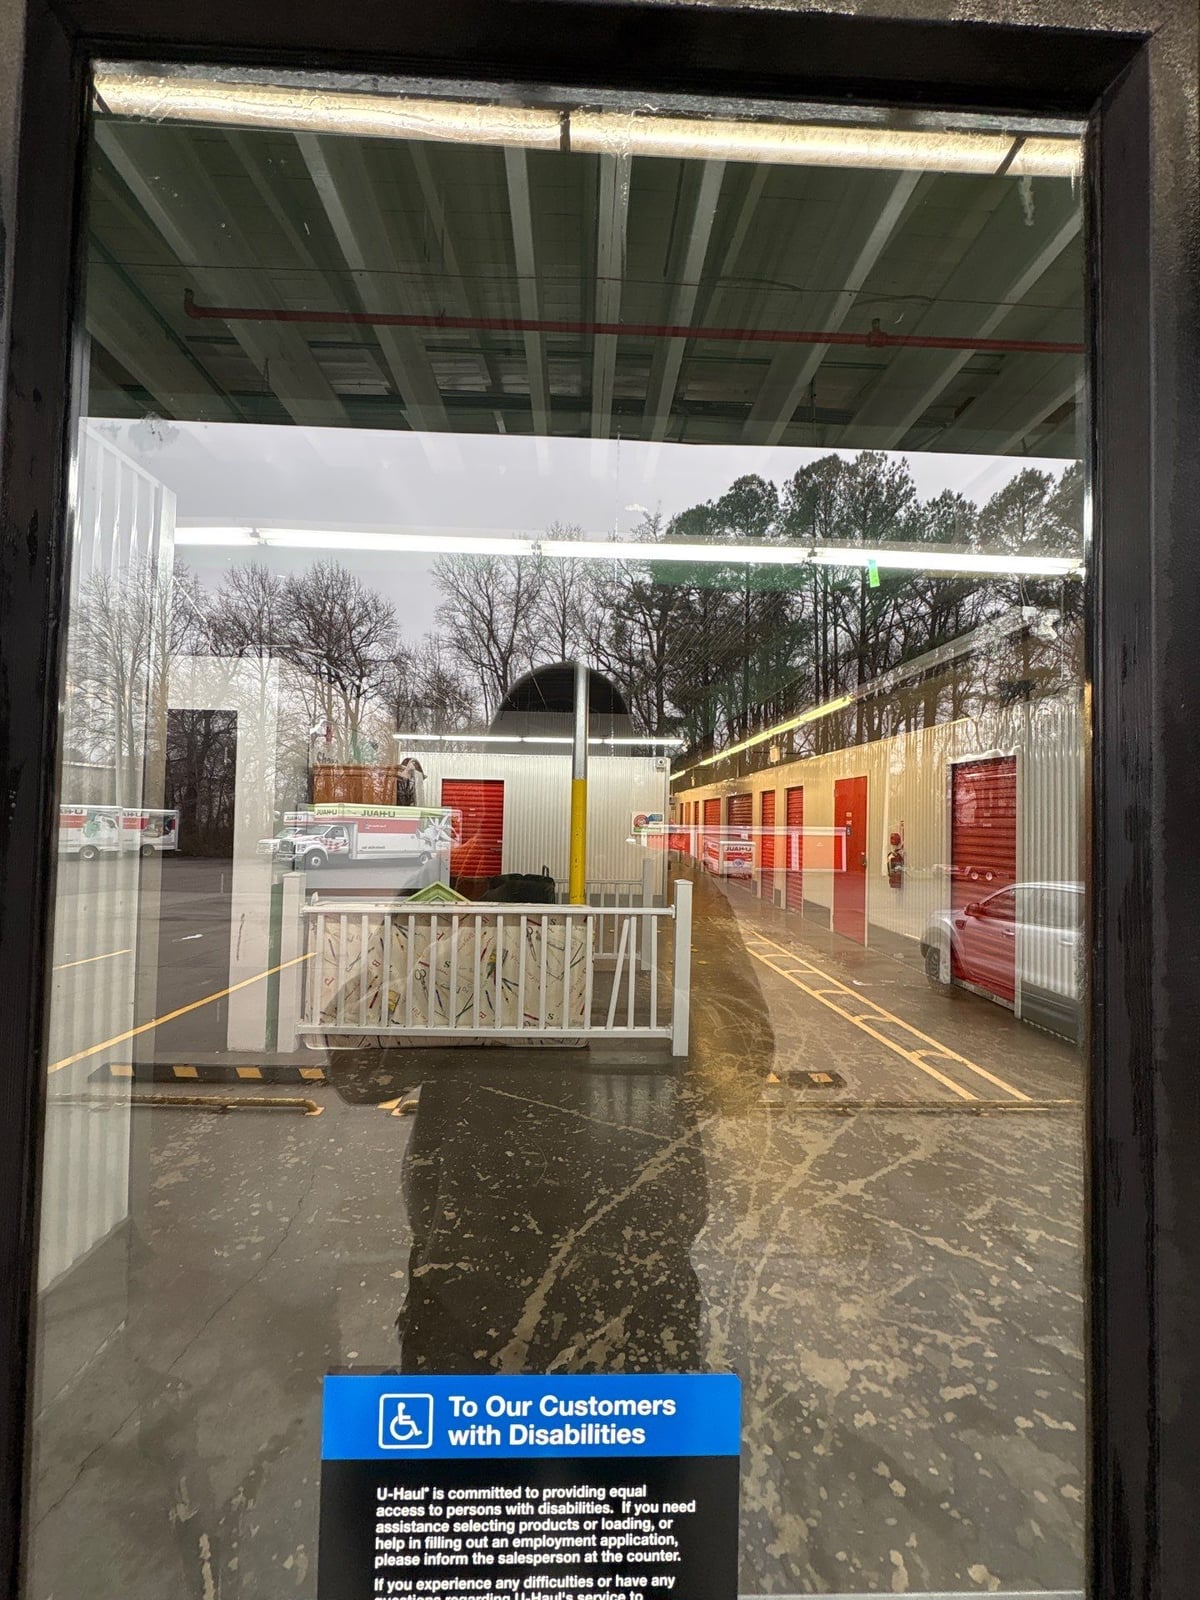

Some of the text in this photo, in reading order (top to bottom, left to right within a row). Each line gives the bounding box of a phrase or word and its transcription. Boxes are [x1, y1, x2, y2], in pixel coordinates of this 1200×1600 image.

[448, 1394, 676, 1417] To Our Customers
[447, 1423, 646, 1446] with Disabilities
[433, 1487, 444, 1499] is
[448, 1486, 521, 1499] committed
[525, 1487, 539, 1498] to
[543, 1485, 606, 1500] providing
[609, 1484, 647, 1499] equal
[376, 1500, 696, 1518] access to persons with disabilities. If you need
[376, 1517, 674, 1534] assistance selecting products or loading, or
[375, 1533, 679, 1552] help in filling out an employment application,
[374, 1550, 682, 1569] please inform the salesperson at the counter.
[374, 1574, 676, 1593] If you experience any difficulties or have any
